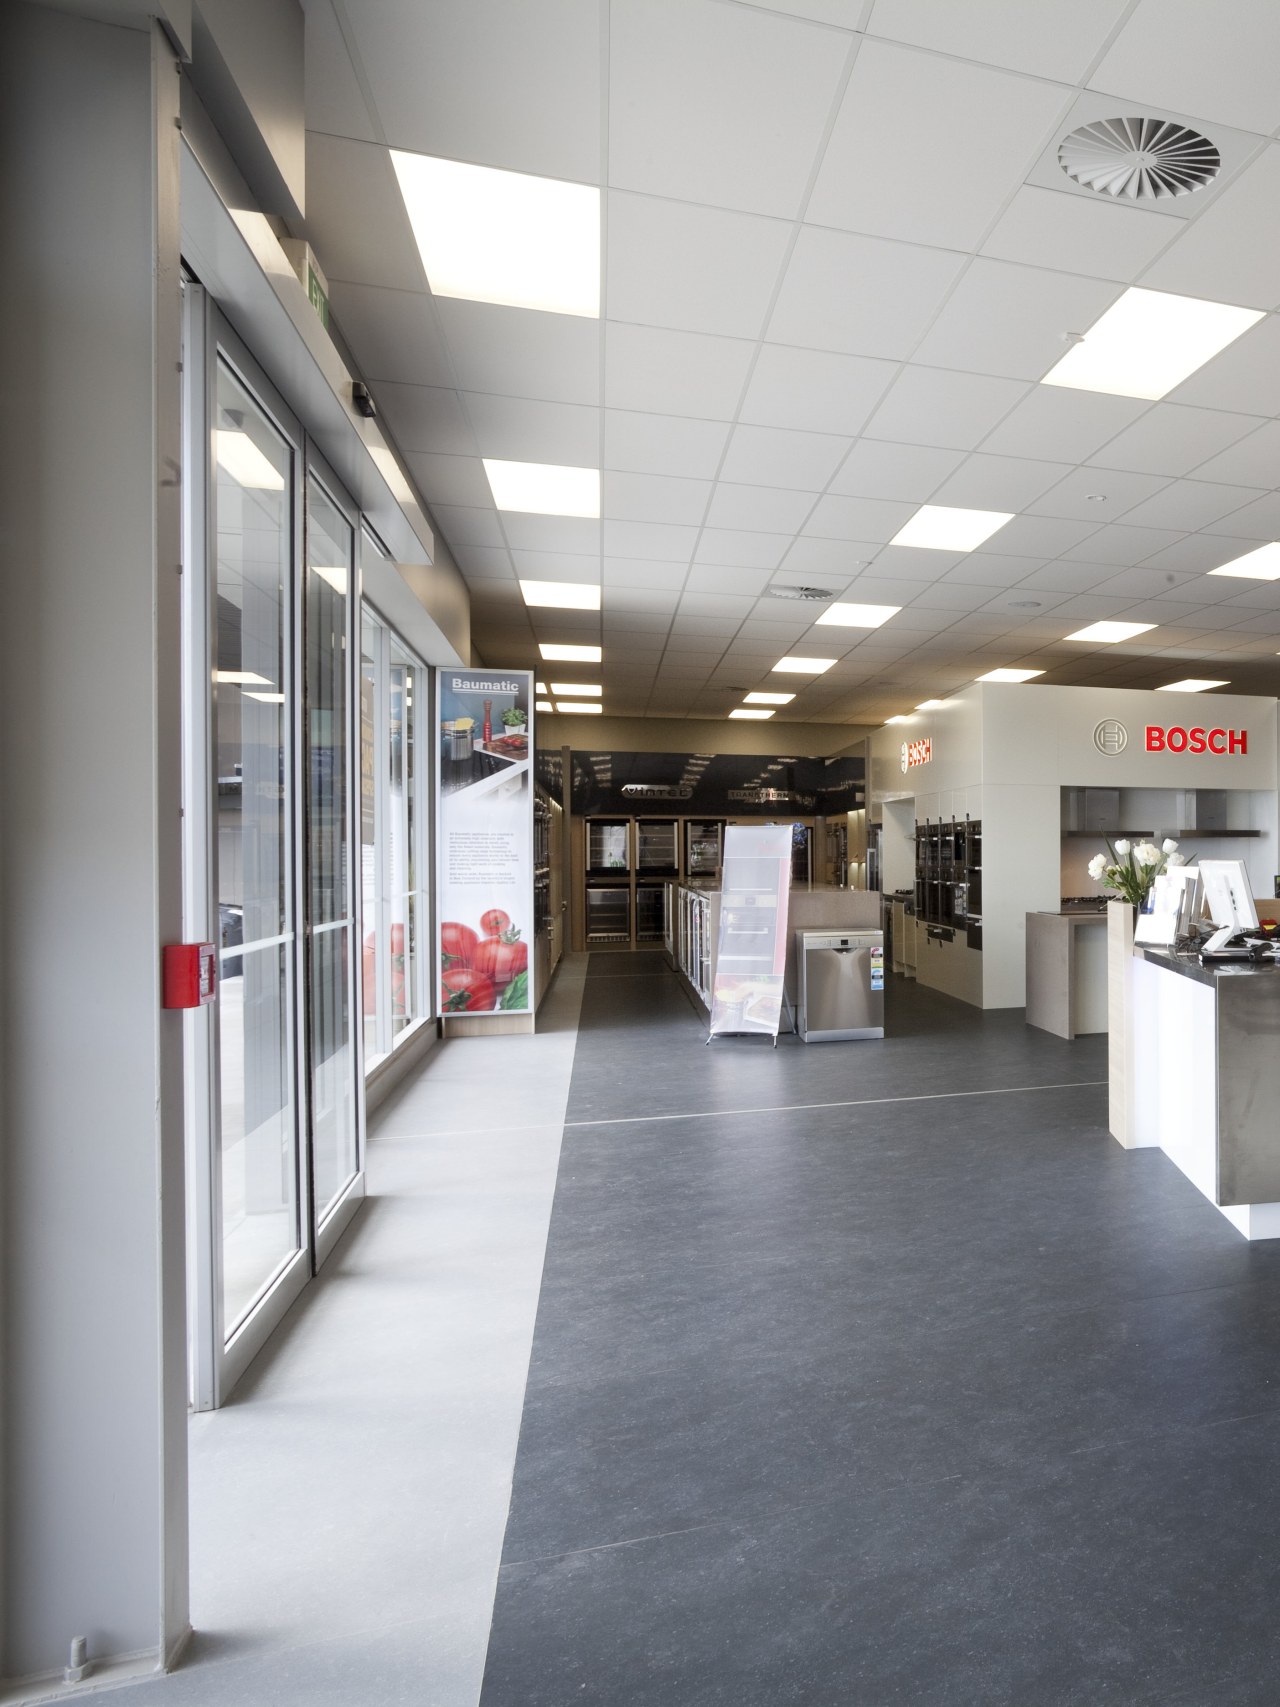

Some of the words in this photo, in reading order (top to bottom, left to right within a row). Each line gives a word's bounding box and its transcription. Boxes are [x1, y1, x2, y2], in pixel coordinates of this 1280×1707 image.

[452, 678, 519, 692] Baumatic
[908, 737, 932, 767] BOSCH
[1145, 725, 1248, 756] BOSCH
